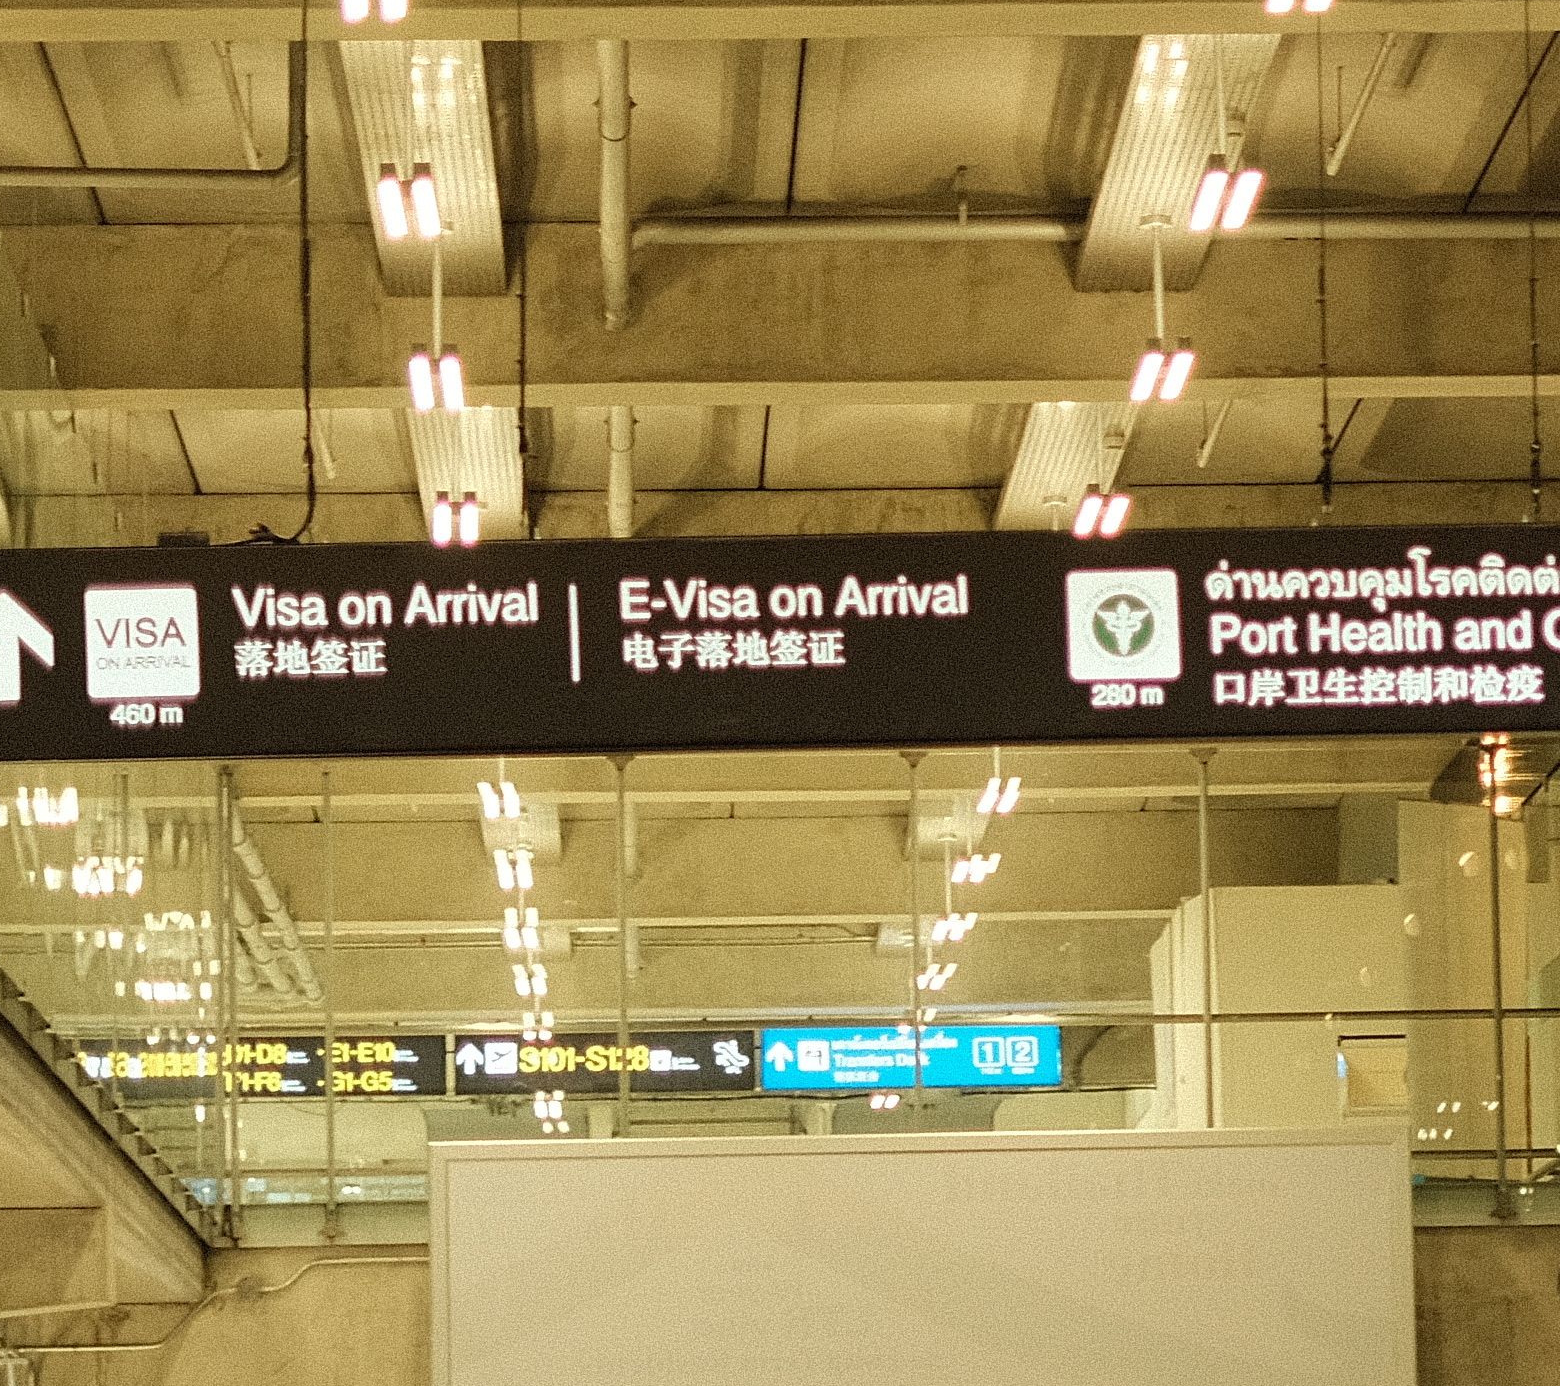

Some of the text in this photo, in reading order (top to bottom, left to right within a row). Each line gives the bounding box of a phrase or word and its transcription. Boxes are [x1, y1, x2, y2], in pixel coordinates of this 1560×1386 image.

[231, 581, 539, 627] Visa on Arrival
[619, 573, 969, 621] E-Visa on Arrival
[95, 616, 187, 648] VISA
[622, 629, 847, 670] 电子落地签证
[1210, 612, 1298, 655] Port
[1308, 610, 1443, 653] Health
[1453, 608, 1534, 652] and
[96, 655, 191, 670] ON ARRIVAL
[233, 637, 388, 677] 落地签证
[1141, 686, 1165, 705] m
[1213, 664, 1545, 707] 口岸卫生控制和检疫
[109, 703, 184, 725] 460 m
[1015, 1041, 1031, 1062] 2
